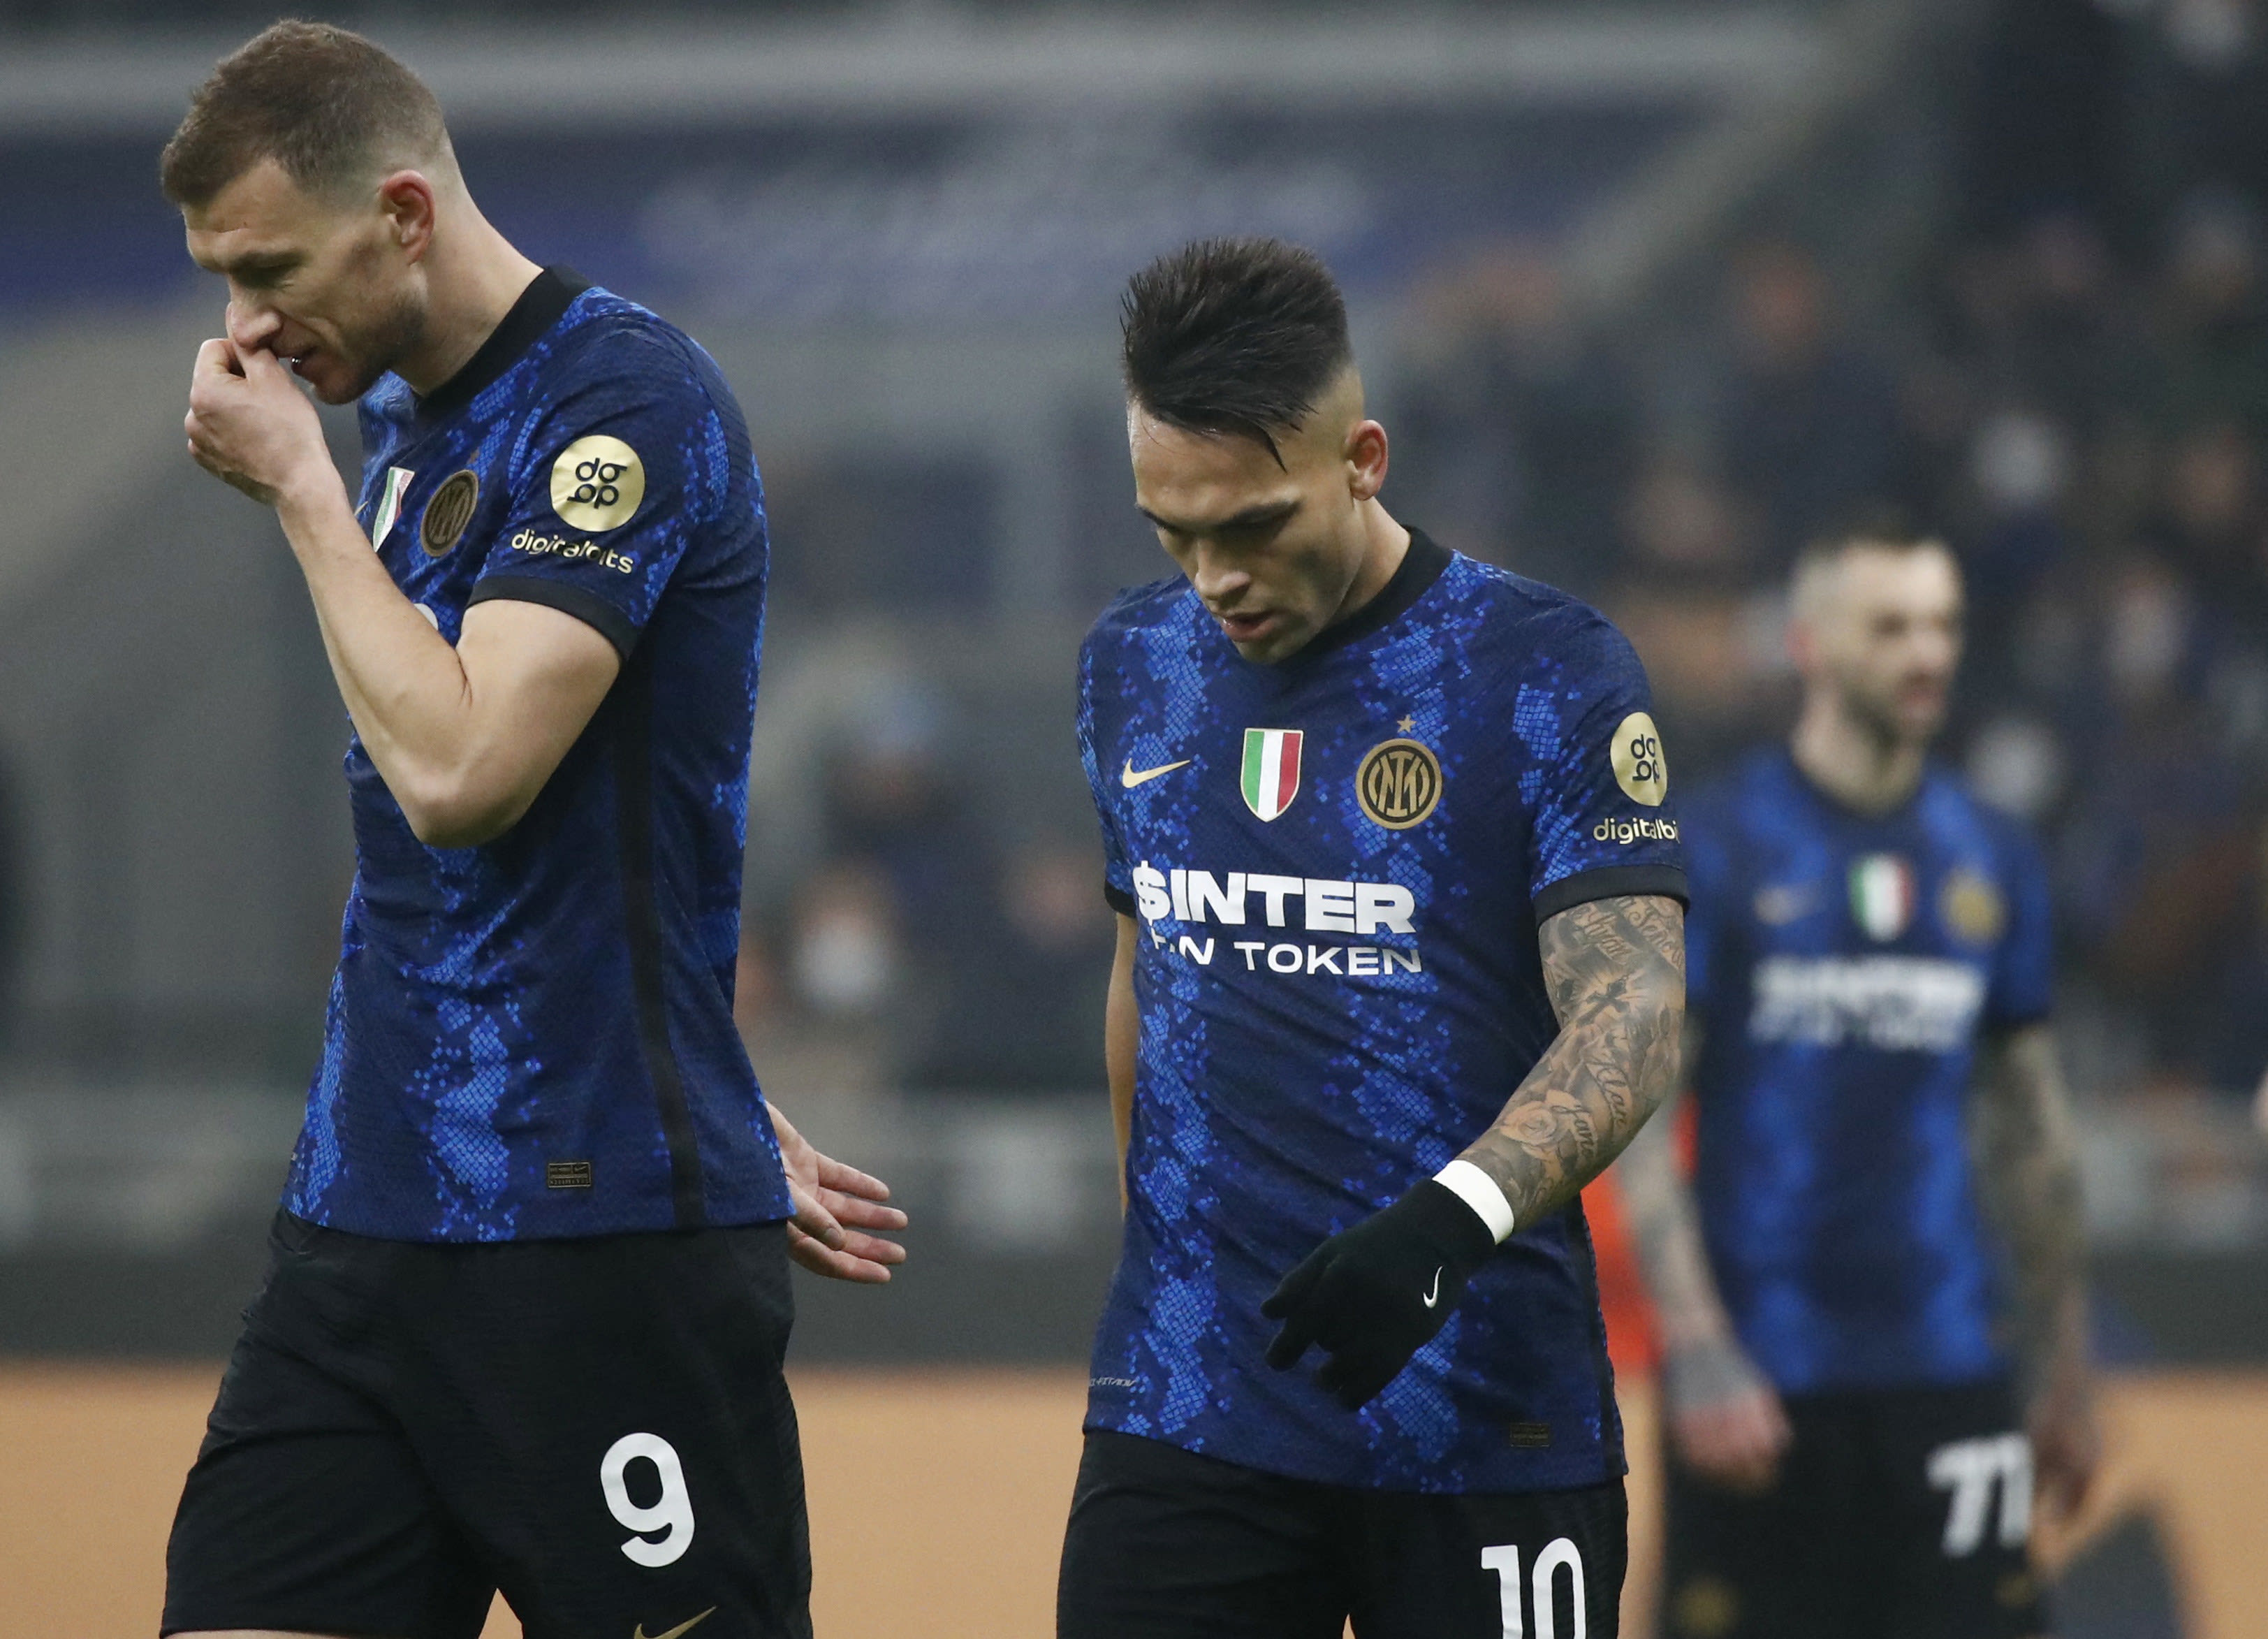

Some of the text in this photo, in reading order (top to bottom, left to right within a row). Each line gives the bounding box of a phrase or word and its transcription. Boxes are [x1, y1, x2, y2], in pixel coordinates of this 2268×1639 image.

[1593, 817, 1681, 845] digitalbi
[1132, 860, 1417, 935] $INTER
[1234, 941, 1422, 976] TOKEN
[600, 1432, 696, 1568] 9
[1481, 1537, 1587, 1639] 10
